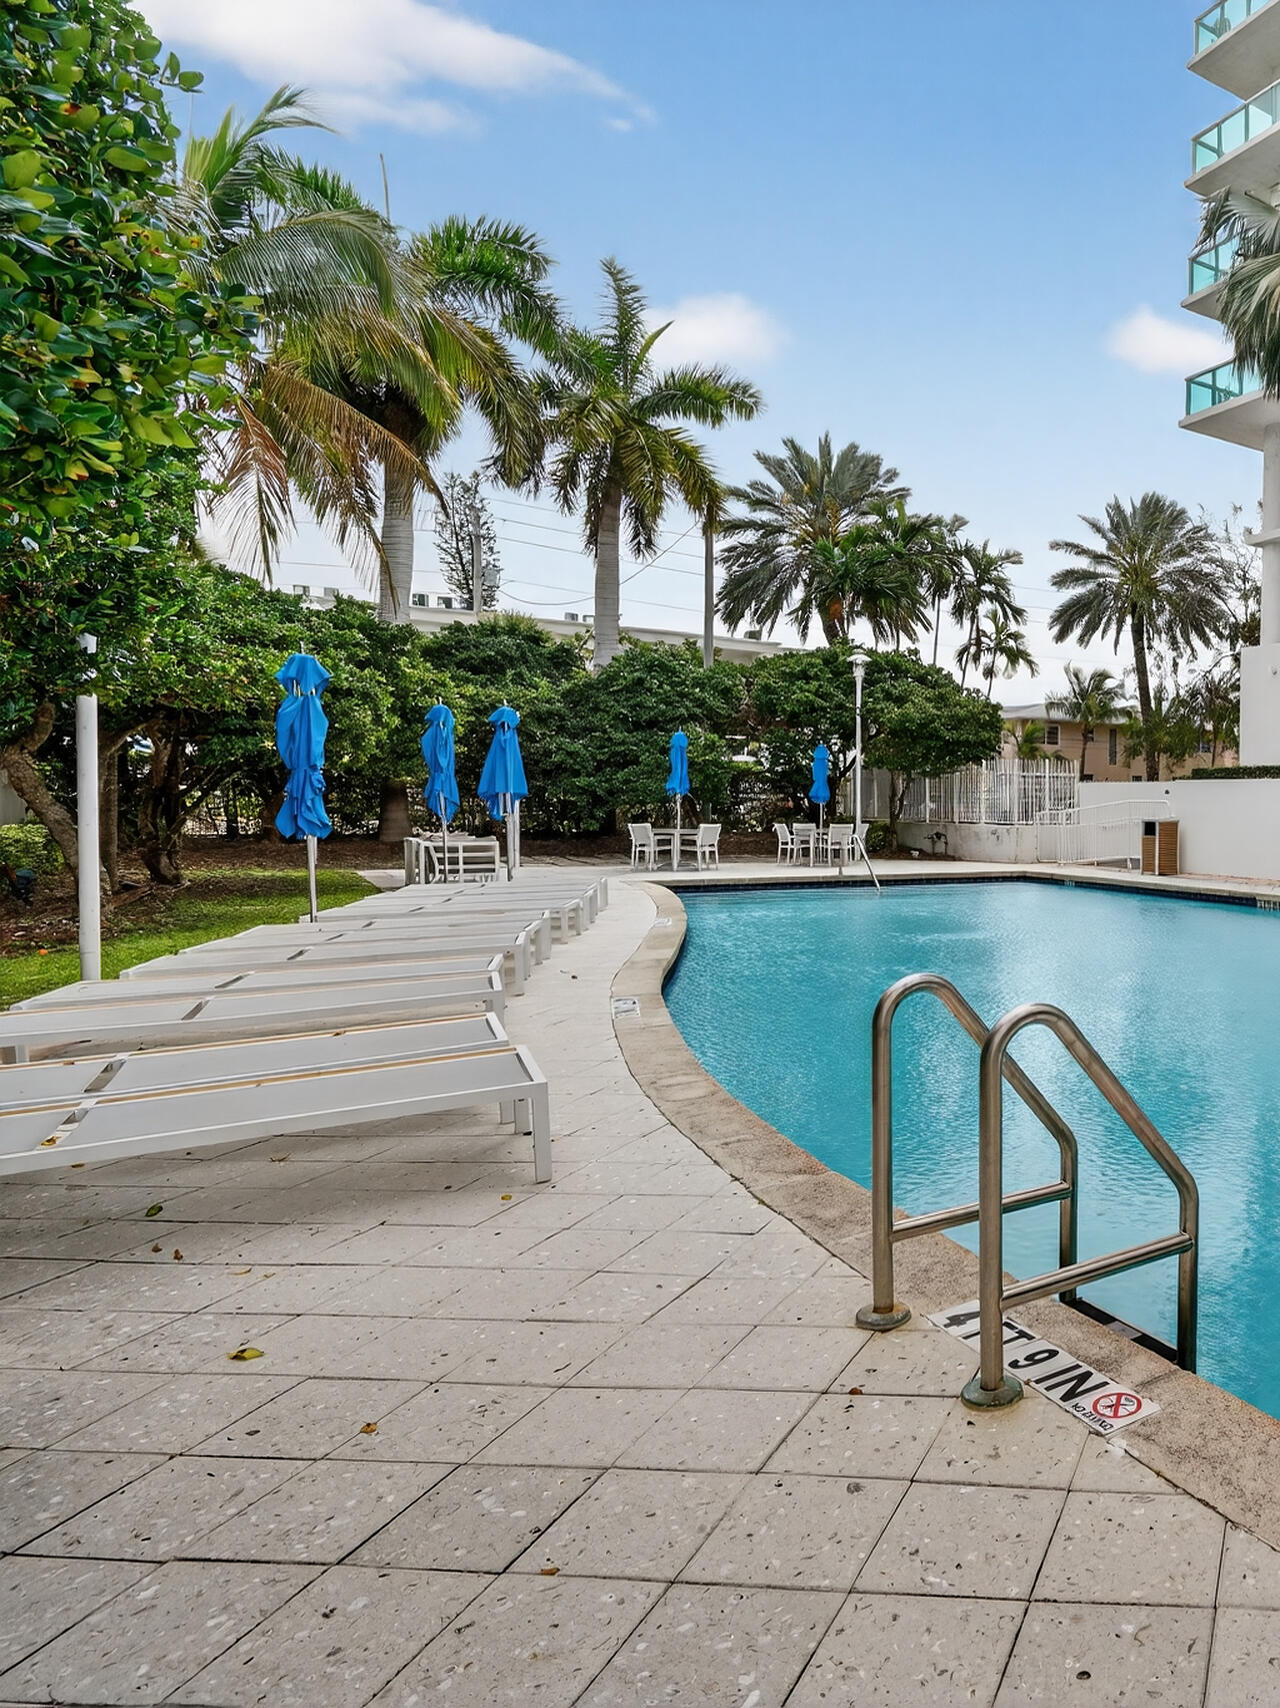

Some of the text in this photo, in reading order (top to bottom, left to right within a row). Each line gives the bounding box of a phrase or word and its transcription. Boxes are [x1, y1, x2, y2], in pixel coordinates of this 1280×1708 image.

[943, 1311, 980, 1328] 4
[1008, 1349, 1059, 1369] 9
[1034, 1364, 1109, 1402] IN
